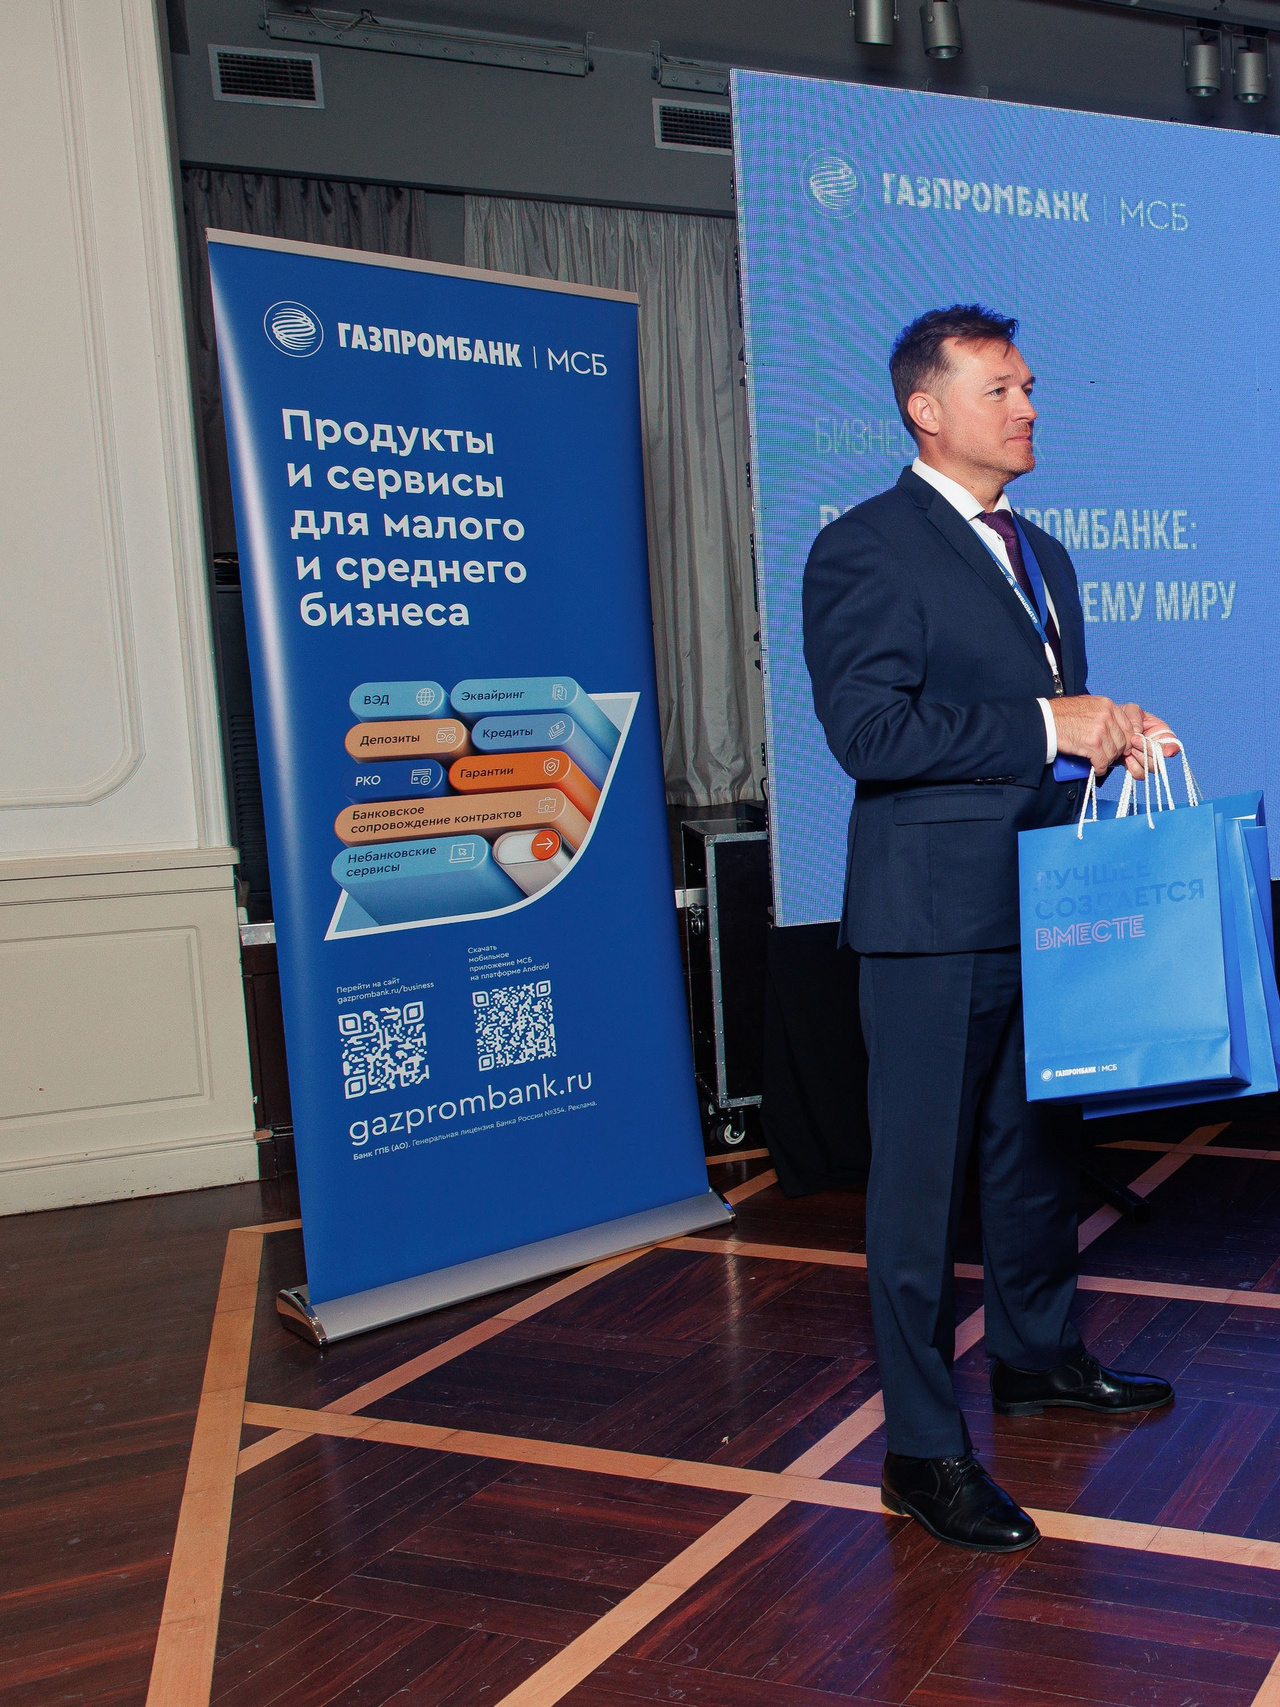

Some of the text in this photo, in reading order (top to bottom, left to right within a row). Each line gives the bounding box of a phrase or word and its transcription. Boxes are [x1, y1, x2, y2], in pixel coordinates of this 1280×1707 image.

[882, 172, 1189, 232] ГАЗПРОМБАНК МСБ
[337, 322, 608, 376] ГАЗПРОМБАНК МСБ
[282, 408, 494, 457] Продукты
[286, 462, 504, 499] и сервисы
[290, 509, 525, 542] для малого
[296, 555, 527, 588] и среднего
[300, 591, 471, 627] бизнеса
[1078, 580, 1237, 623] ЕМУ МИРУ
[363, 694, 390, 707] ВЭД
[461, 689, 525, 704] Эквайринг
[359, 733, 420, 748] Депозиты
[482, 726, 533, 740] Кредиты
[355, 774, 381, 787] РКО
[459, 766, 514, 780] Гарантии
[350, 808, 522, 835] сопровождение контрактов
[352, 804, 425, 821] Банковское
[347, 844, 437, 865] Небанковские
[346, 862, 401, 878] сервисы
[1035, 914, 1146, 950] ВМЕСТЕ
[467, 945, 498, 954] Скачать
[468, 952, 510, 963] мобильное
[469, 956, 533, 973] приложение МСБ
[480, 968, 522, 979] платформе
[522, 962, 550, 973] Android
[336, 982, 371, 994] Перейти
[383, 977, 400, 986] сайт
[337, 982, 435, 1004] gazprombank.ru/business
[1101, 1063, 1118, 1072] МСБ
[349, 1071, 593, 1146] gazprombank.ru
[353, 1150, 373, 1161] Банк
[374, 1146, 390, 1156] ГПБ
[391, 1142, 411, 1153] (АО).
[412, 1131, 459, 1146] Генеральная
[460, 1123, 495, 1137] лицензия
[496, 1118, 517, 1128] Банка
[517, 1112, 544, 1123] России
